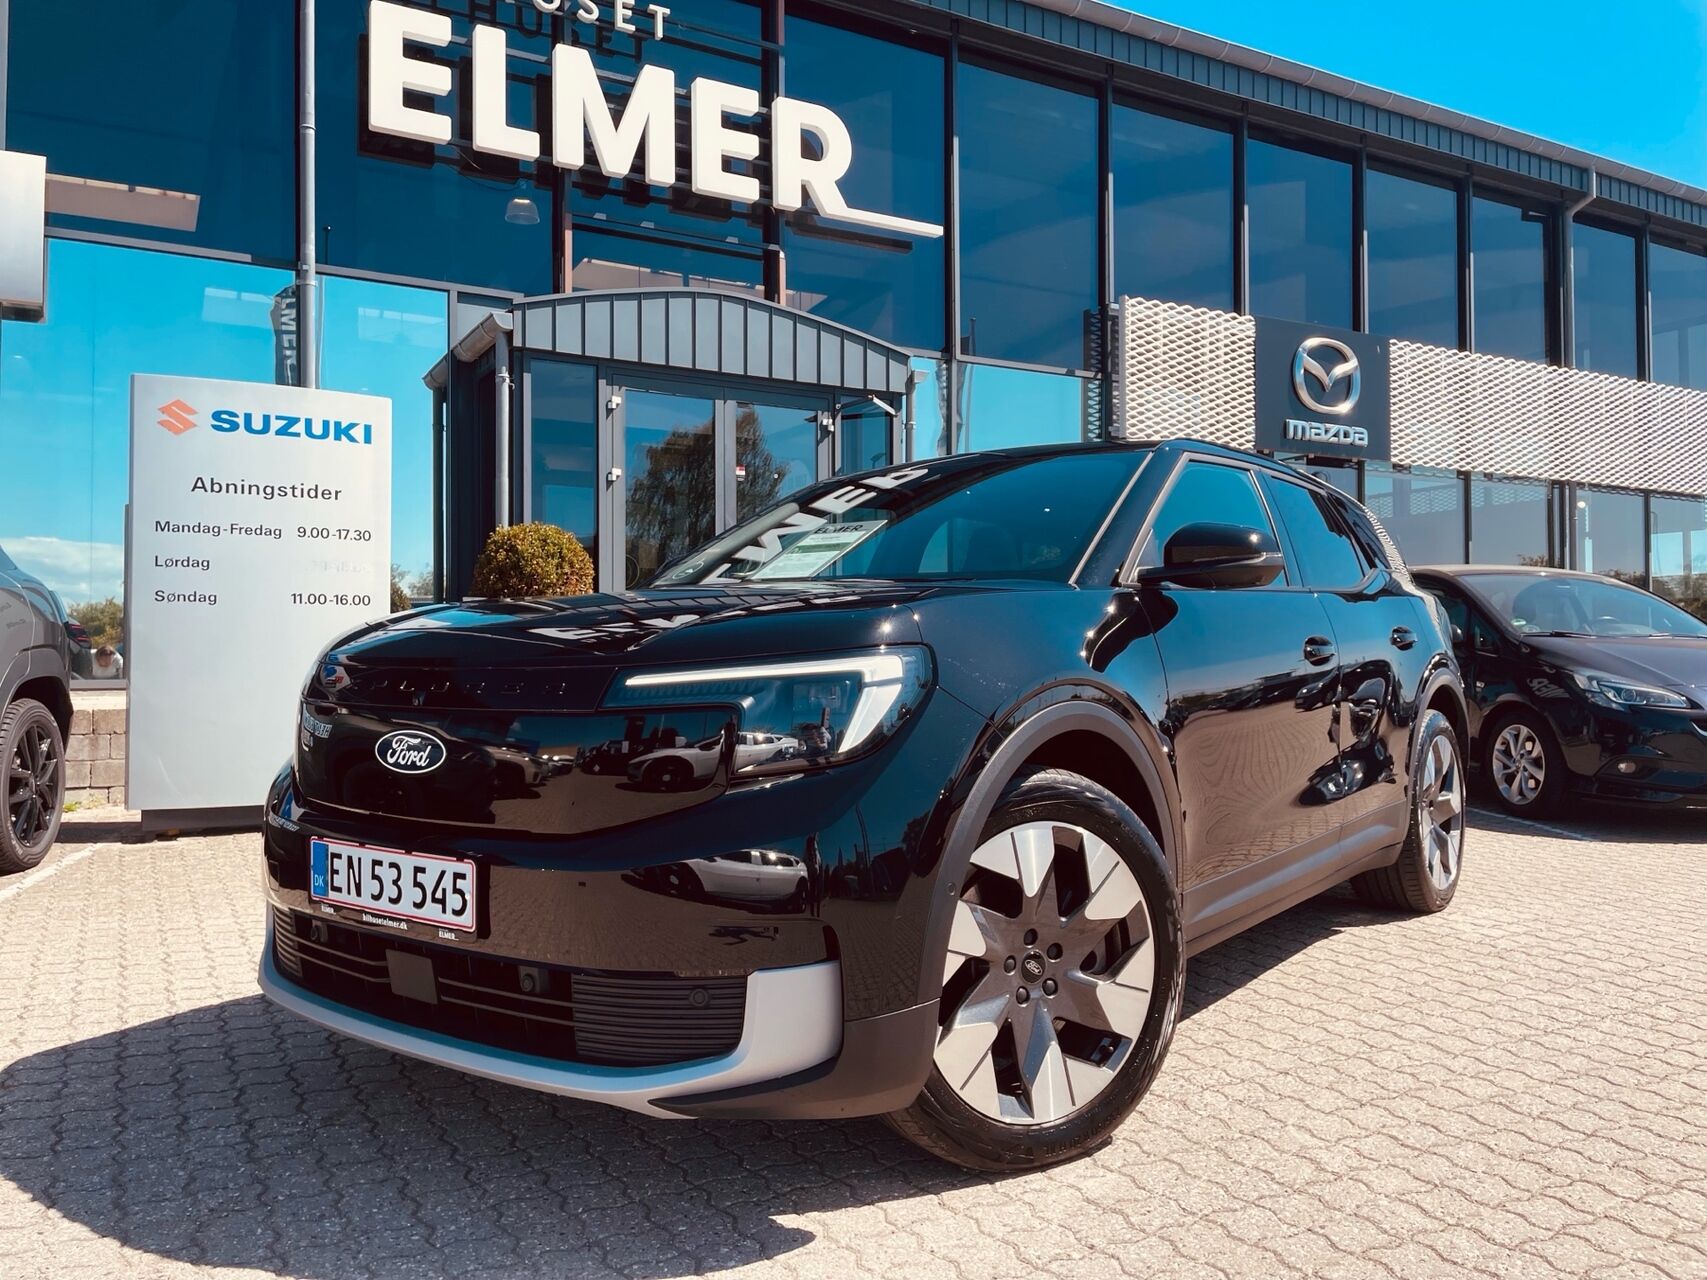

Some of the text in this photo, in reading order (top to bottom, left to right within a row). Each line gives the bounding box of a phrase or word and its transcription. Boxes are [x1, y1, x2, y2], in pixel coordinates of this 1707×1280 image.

[367, 0, 945, 240] ELMER
[210, 409, 372, 445] SUZUKI
[1285, 418, 1369, 447] mazda
[190, 476, 342, 501] Abningstider
[154, 520, 372, 542] Mandag-Fredag 9.00-17.30
[154, 555, 211, 571] Lørdag
[154, 590, 371, 607] Søndag 11.00-16.00
[384, 734, 434, 768] Ford
[314, 874, 324, 887] DK
[329, 851, 468, 918] EN 53 545
